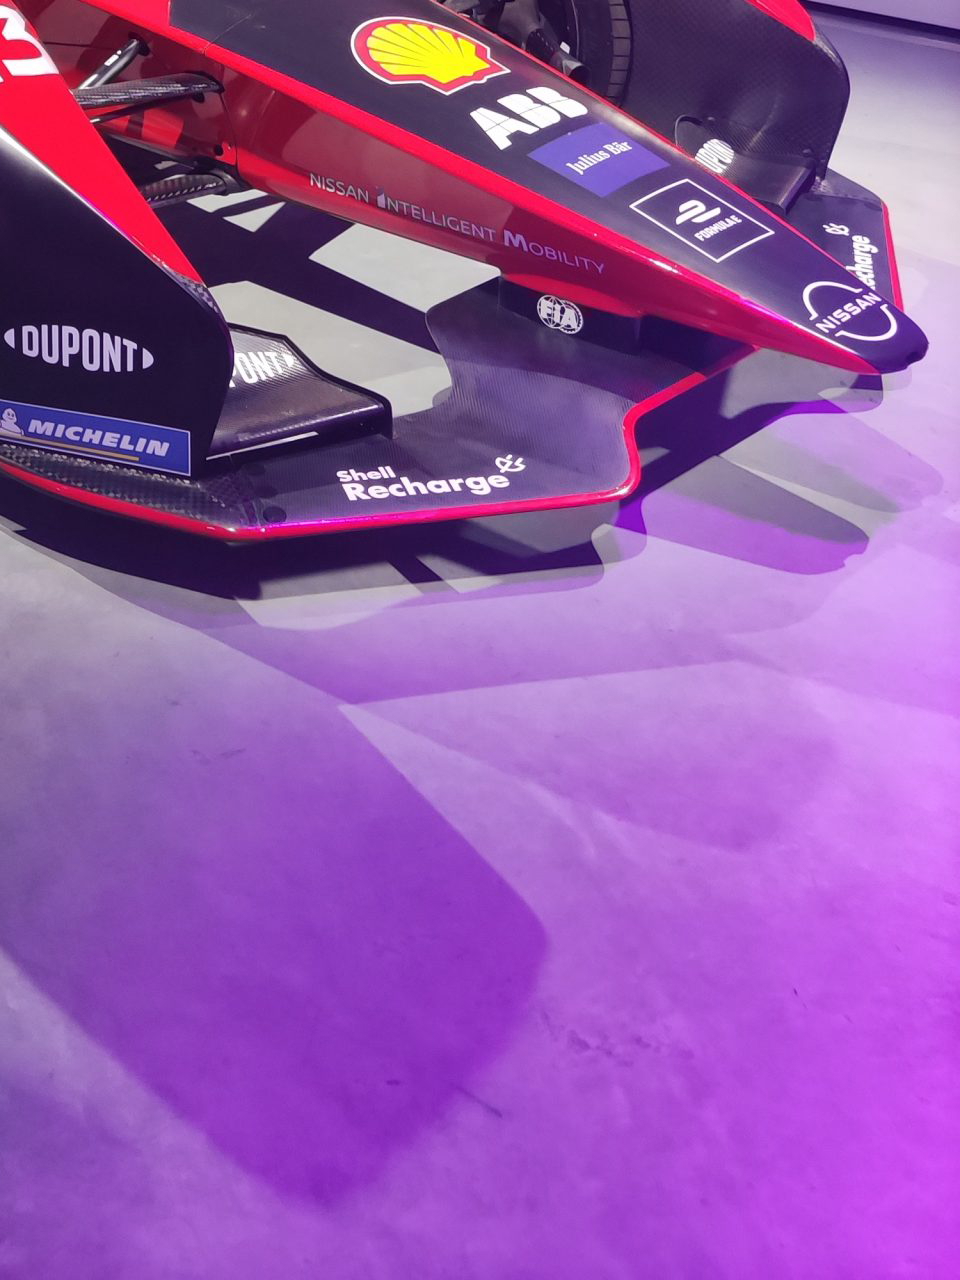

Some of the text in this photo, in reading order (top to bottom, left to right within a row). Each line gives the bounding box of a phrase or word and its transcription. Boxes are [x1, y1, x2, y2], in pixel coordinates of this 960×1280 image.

[470, 86, 588, 150] ABB
[566, 141, 633, 175] Julius Bär
[309, 173, 369, 203] NISSAN
[503, 229, 605, 274] MOBILITY
[845, 235, 879, 290] echarge
[540, 298, 578, 330] FIA
[815, 292, 882, 333] NISSAN
[22, 324, 138, 372] DUPONT
[28, 419, 170, 457] MICHELIN
[336, 465, 396, 482] Shell
[342, 474, 510, 501] Recharge
